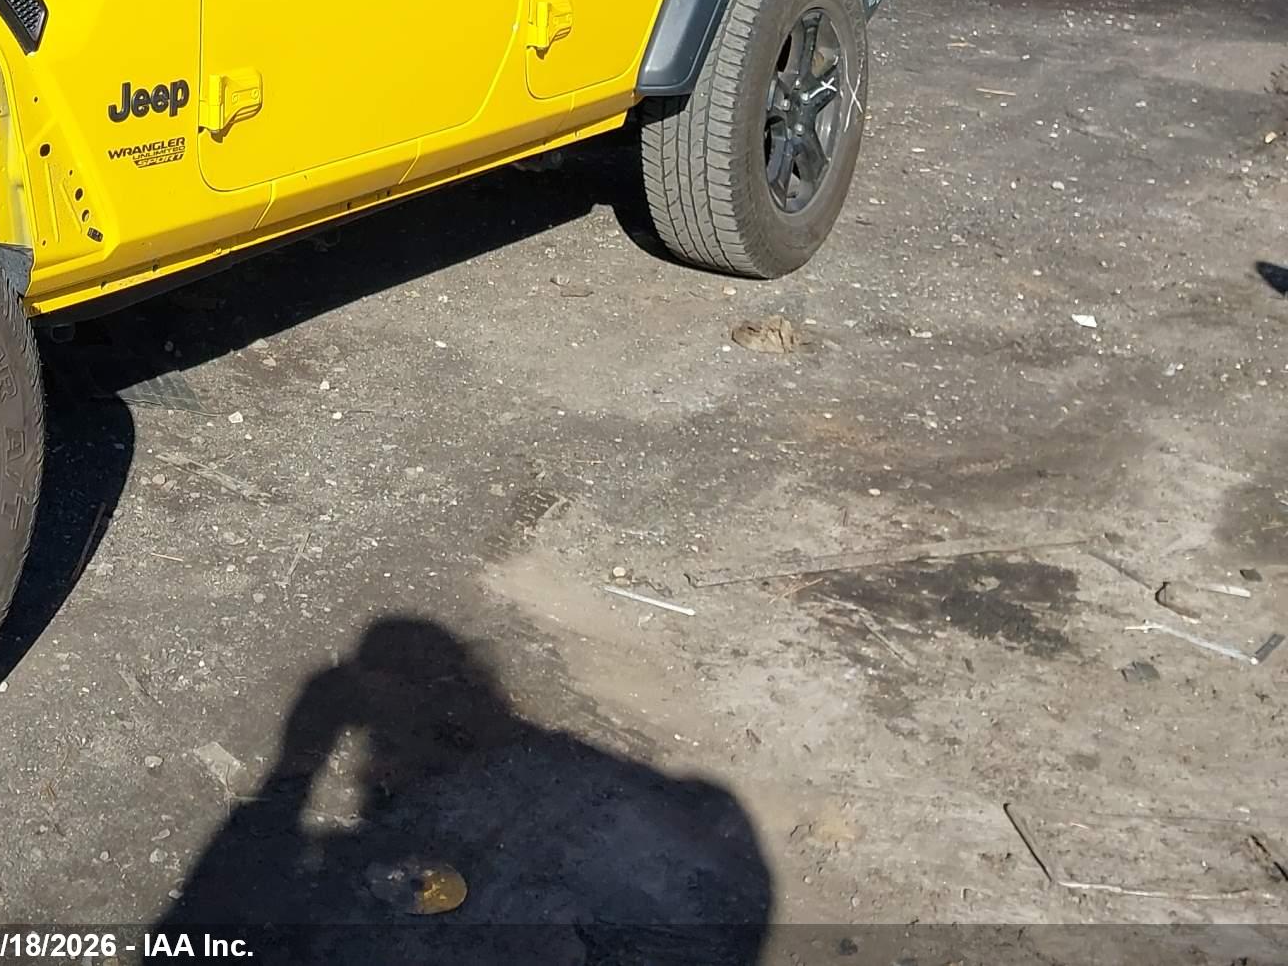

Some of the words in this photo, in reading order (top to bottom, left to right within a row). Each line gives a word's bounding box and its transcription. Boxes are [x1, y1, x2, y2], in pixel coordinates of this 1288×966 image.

[108, 79, 190, 123] Jeep
[108, 136, 186, 160] WRANGLER
[132, 146, 186, 160] UNLIMITED
[134, 153, 185, 167] SPORT
